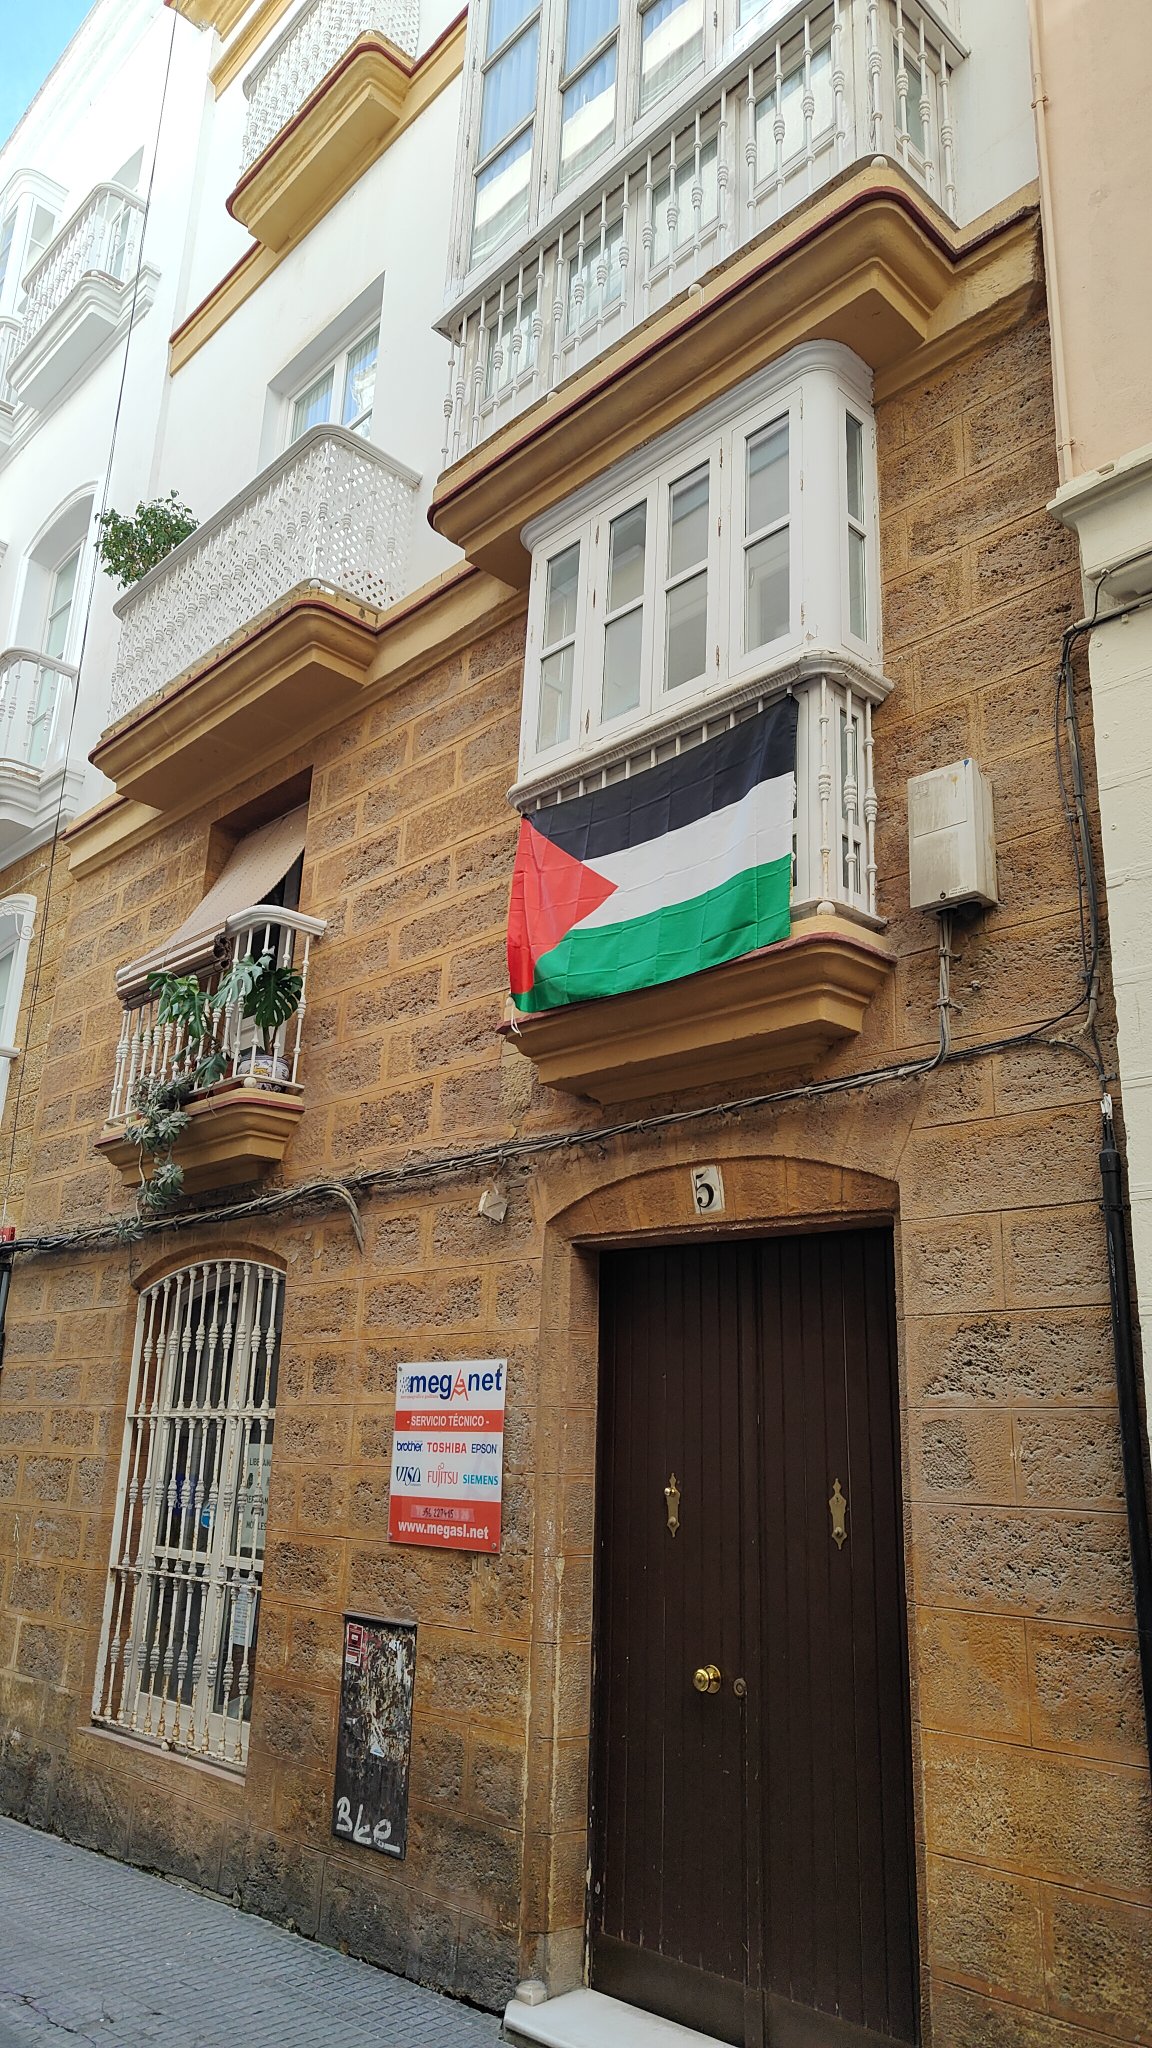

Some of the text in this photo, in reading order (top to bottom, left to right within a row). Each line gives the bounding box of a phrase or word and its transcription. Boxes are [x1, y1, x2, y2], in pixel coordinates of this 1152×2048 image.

[695, 1169, 714, 1208] 5
[411, 1413, 485, 1427] SERVICIO TÉCNICO
[396, 1440, 497, 1454] brother TOSHIBA EPSON
[395, 1463, 499, 1487] VISA FUJITSU SIEMENS
[398, 1521, 489, 1540] www.megasl.net
